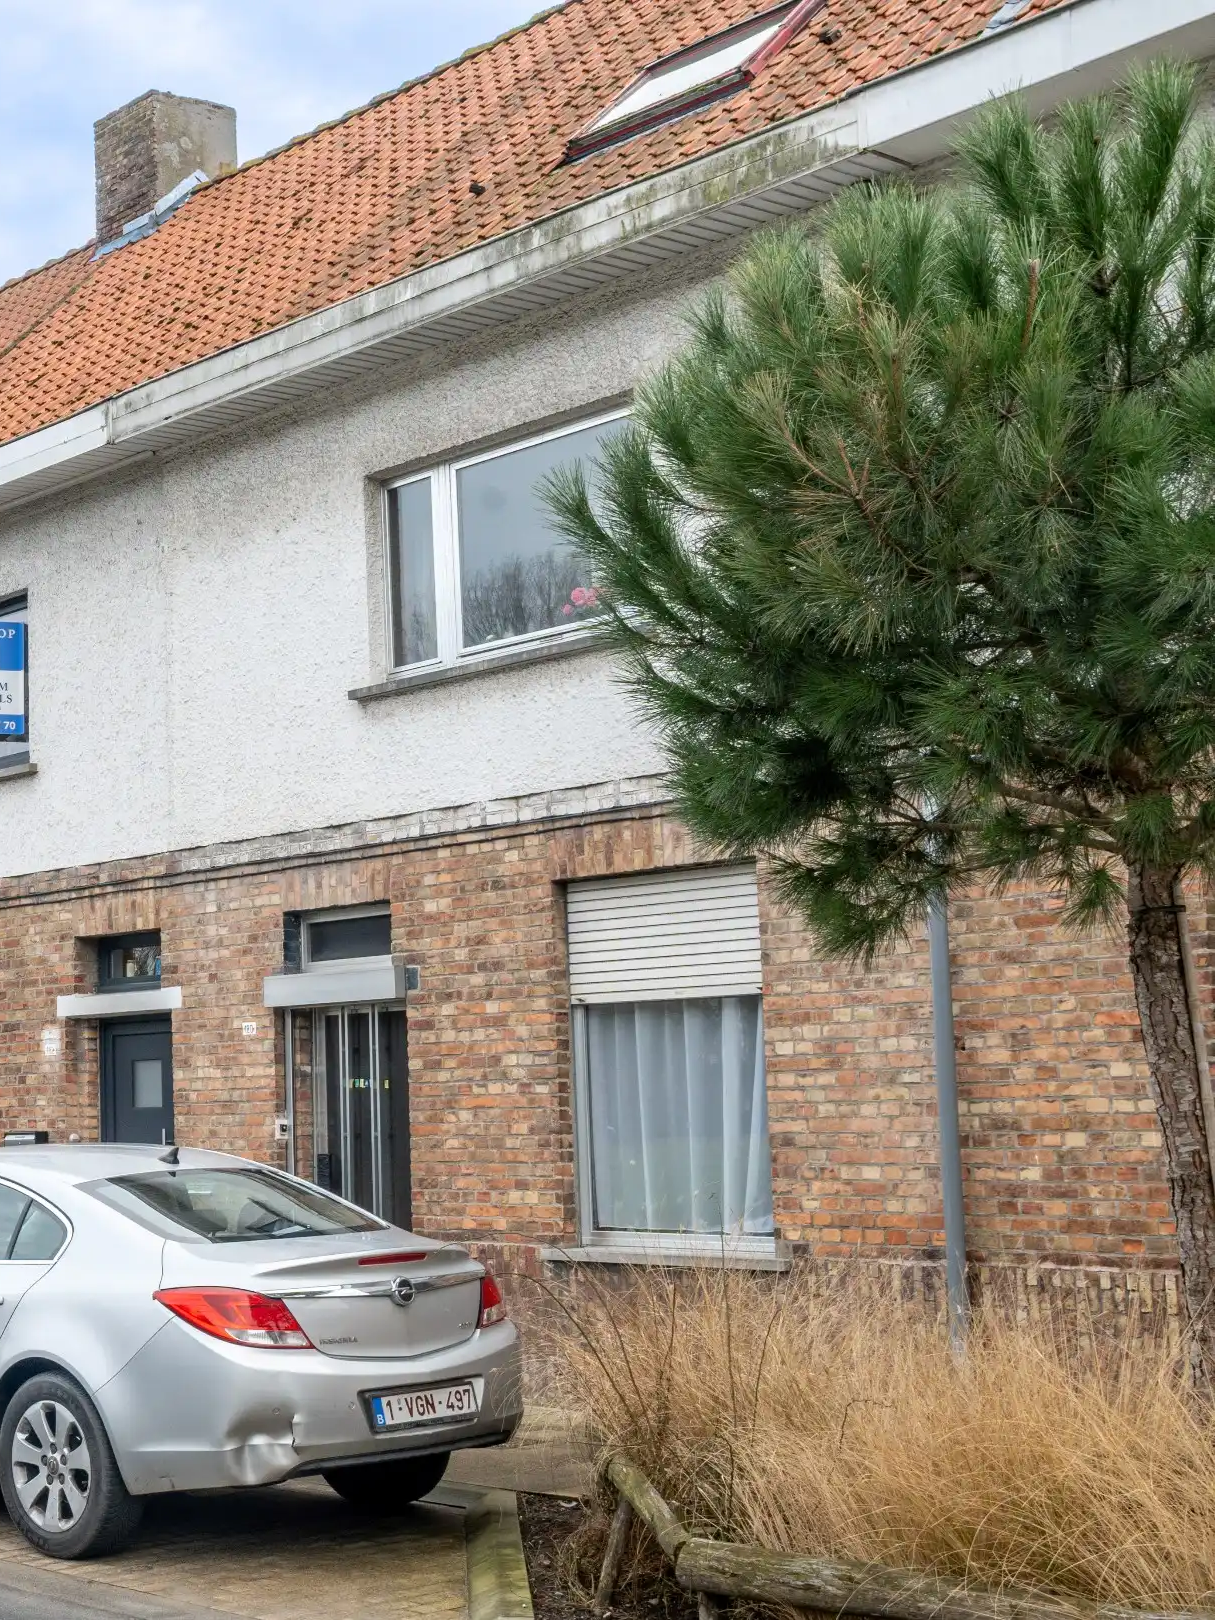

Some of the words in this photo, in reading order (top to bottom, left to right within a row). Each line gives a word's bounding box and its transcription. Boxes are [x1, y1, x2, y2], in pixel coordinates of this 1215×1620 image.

[3, 721, 16, 730] 70
[376, 1414, 385, 1425] B
[385, 1388, 471, 1421] 1-VGN-497
